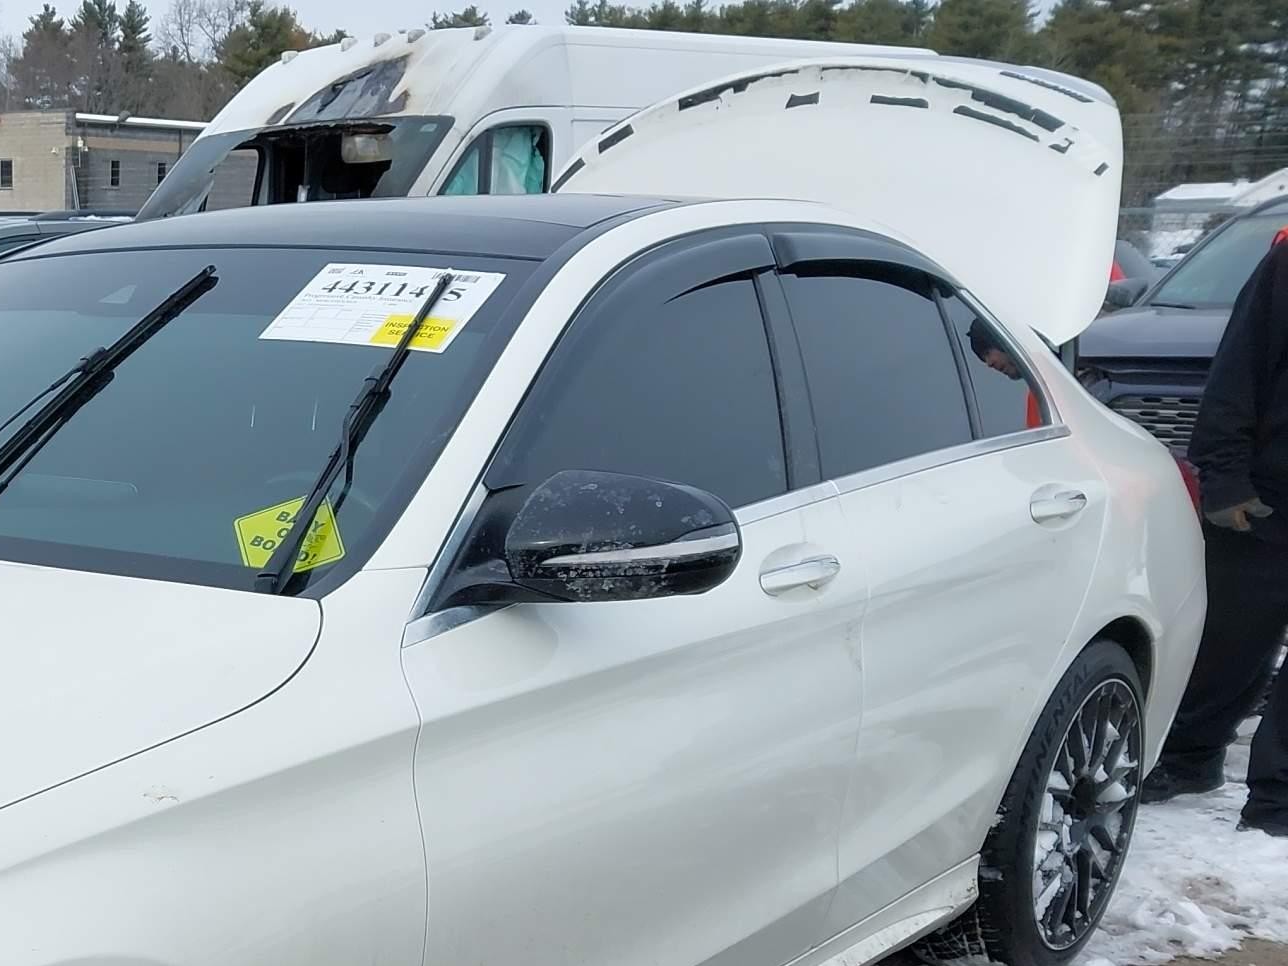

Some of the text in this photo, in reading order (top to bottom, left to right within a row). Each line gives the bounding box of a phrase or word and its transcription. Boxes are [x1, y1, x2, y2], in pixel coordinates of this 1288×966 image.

[321, 280, 467, 301] 4431145
[385, 321, 449, 332] INSPTION
[387, 329, 436, 338] SEICE
[276, 511, 325, 533] BY
[250, 536, 317, 564] BOD!
